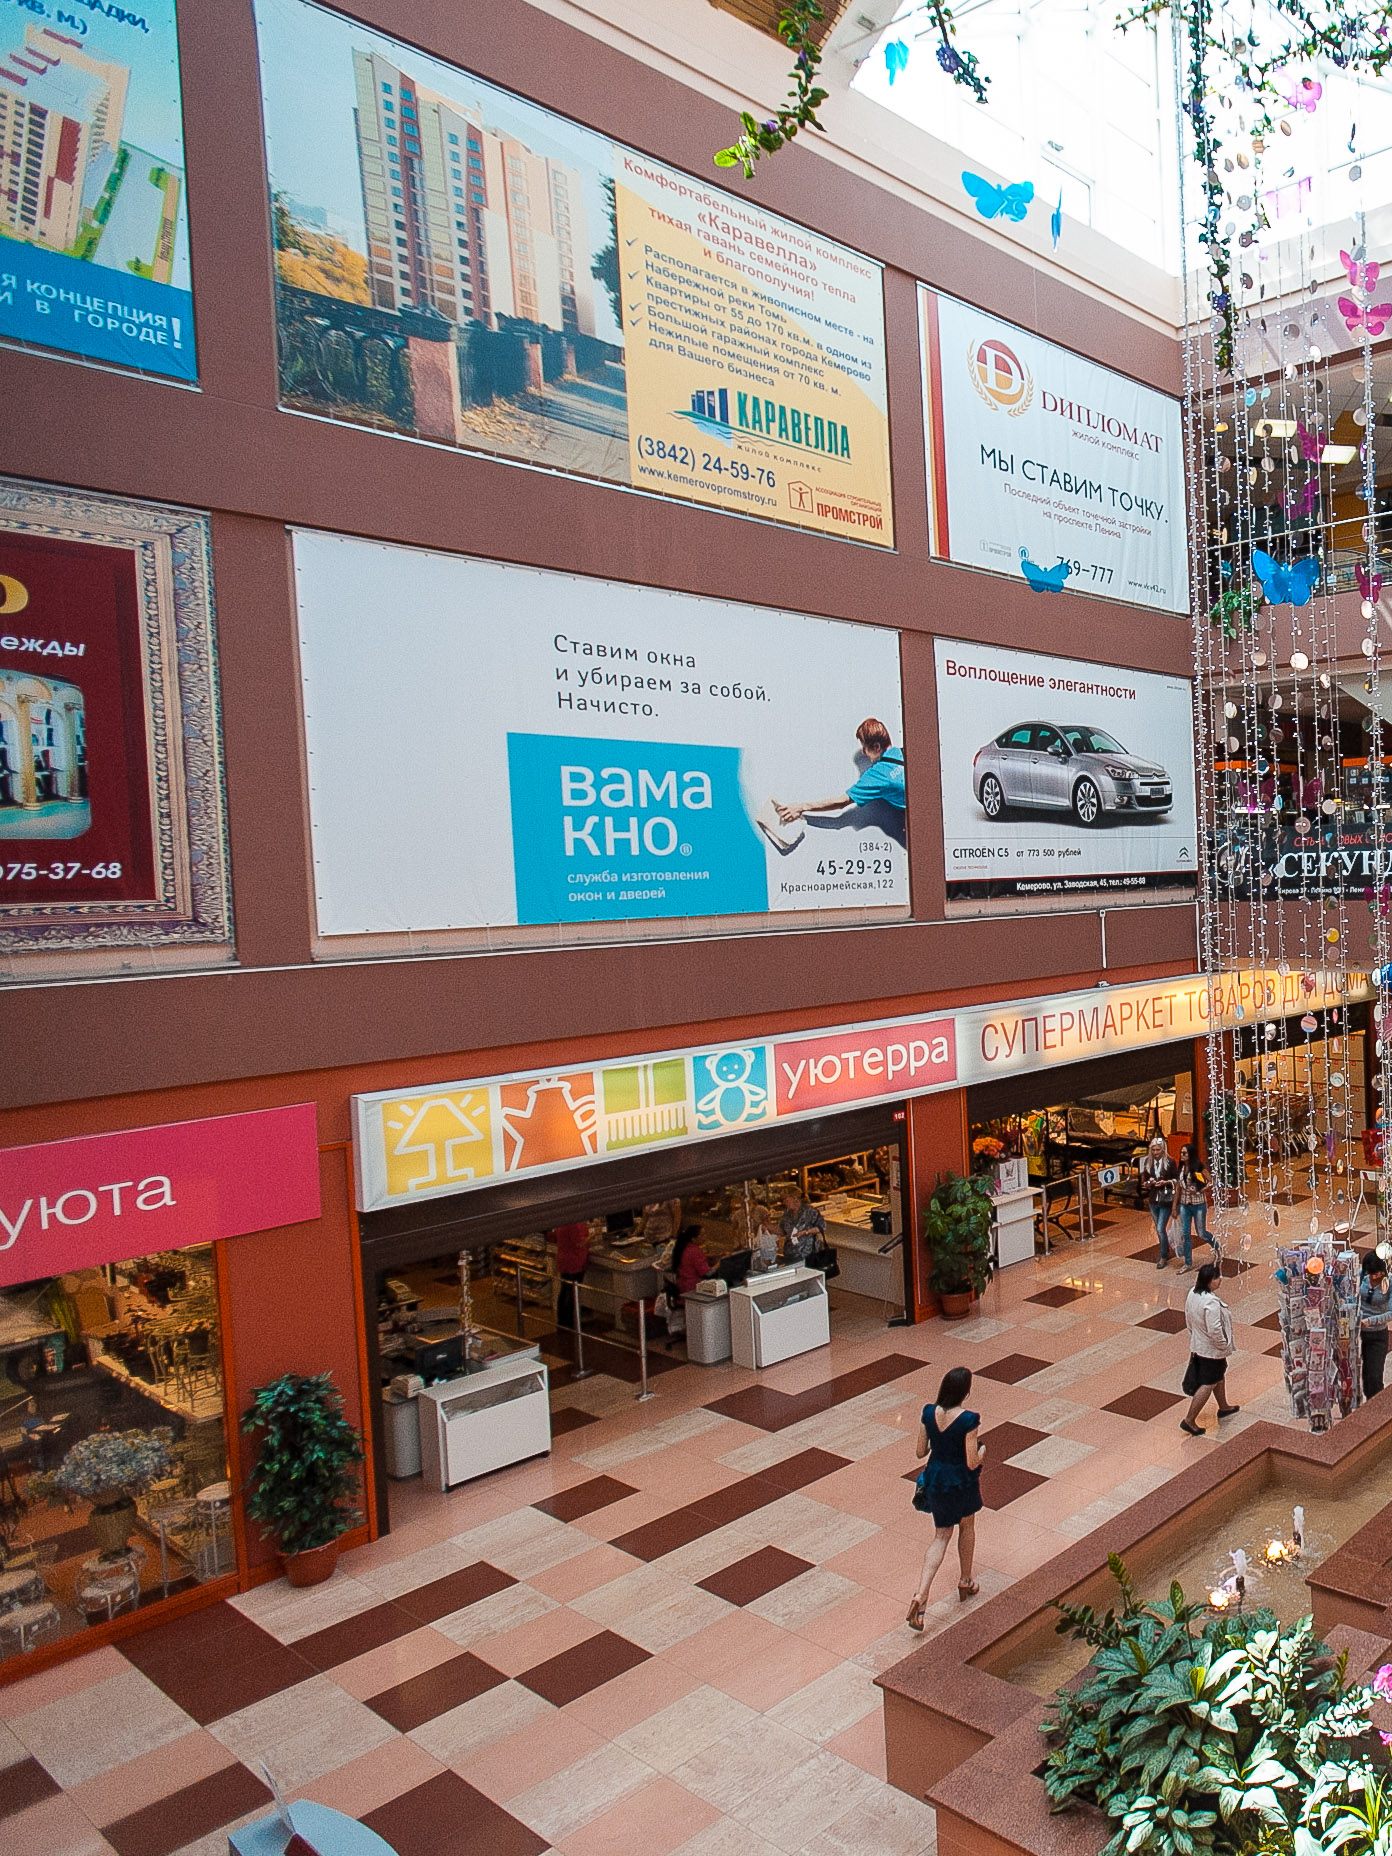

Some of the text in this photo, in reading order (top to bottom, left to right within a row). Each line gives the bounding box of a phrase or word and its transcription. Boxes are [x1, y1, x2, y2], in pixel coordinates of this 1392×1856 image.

[624, 157, 872, 280] Комфортабельный жилой комплекс
[697, 211, 817, 272] «Каравелла»
[648, 207, 856, 304] тихая гавань семейного тепла
[703, 247, 815, 302] и благополучия!
[26, 279, 167, 330] КОНЦЕПЦИЯ
[35, 299, 50, 314] В
[644, 245, 874, 346] Располагается в живописном месте на
[645, 260, 788, 324] Набережной реки Томь
[645, 275, 715, 308] Квартиры
[714, 302, 726, 313] от
[730, 307, 744, 320] 55
[747, 315, 762, 329] до
[765, 320, 784, 336] 170
[816, 341, 823, 350] в
[826, 344, 858, 365] одном
[861, 358, 872, 371] из
[646, 292, 871, 382] престижных районах города Кемерово
[647, 305, 824, 378] Большой гаражный комплекс
[648, 320, 708, 351] Нежилые
[712, 344, 780, 375] помещения
[783, 369, 795, 380] от
[798, 372, 810, 386] 70
[813, 379, 828, 391] кв.
[648, 337, 775, 387] для Вашего бизнеса
[736, 391, 851, 460] КАРАВЕЛЛА
[1072, 429, 1139, 461] жилой комплекс
[637, 434, 776, 488] (3842) 24-59-76
[638, 465, 777, 507] www.kemerovopromstroy.ru
[773, 454, 822, 473] комплекс
[980, 444, 1168, 524] МЫ СТАВИМ ТОЧКУ.
[816, 502, 883, 530] ПРОМСТРОЙ
[1003, 482, 1152, 537] Последний объект точечной застройки
[1042, 510, 1122, 539] на проспекте Ленина
[1056, 555, 1113, 584] 769-777
[554, 633, 696, 668] Ставим окна
[555, 667, 771, 702] и убираем за собой.
[557, 692, 659, 718] Начисто.
[946, 660, 1136, 700] Воплощение элегантности
[816, 859, 892, 876] 45-29-29
[859, 841, 892, 854] (384-2)
[953, 845, 1081, 859] CITROËN C5 от 773 500 рублей
[567, 869, 709, 885] служба изготовления
[568, 886, 666, 902] окон и дверей
[1016, 881, 1051, 892] Кемерово,
[1053, 882, 1063, 891] ул.
[1064, 879, 1099, 890] Заводская,
[980, 993, 1178, 1063] СУПЕРМАРКЕТ
[1183, 978, 1276, 1022] ТОВАРОВ
[781, 1031, 950, 1100] уютерра
